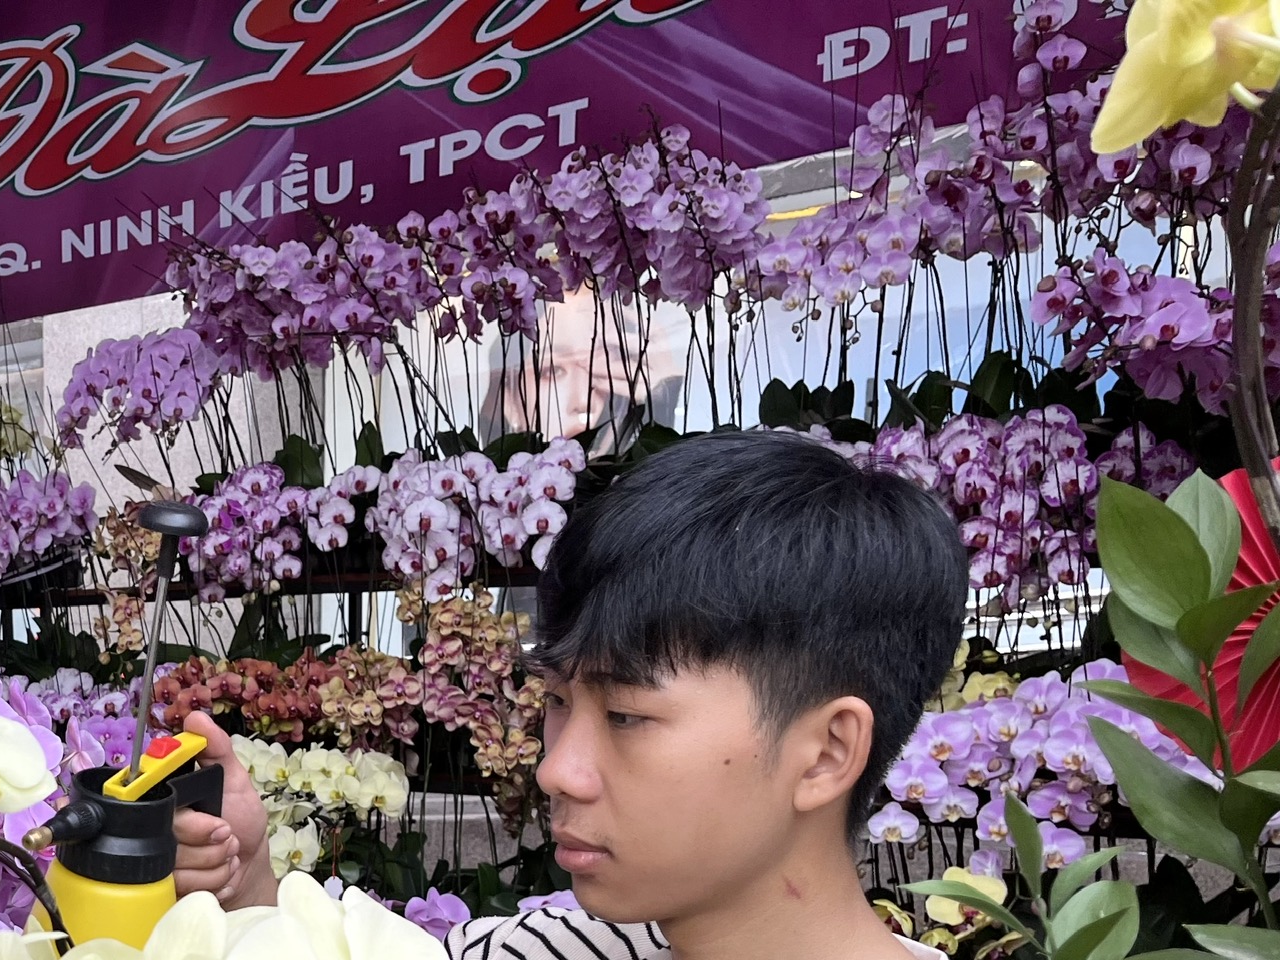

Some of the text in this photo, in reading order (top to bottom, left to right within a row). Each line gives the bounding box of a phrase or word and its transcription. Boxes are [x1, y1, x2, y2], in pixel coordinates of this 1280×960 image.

[816, 6, 969, 83] ĐT:
[61, 199, 195, 264] NINH
[219, 152, 375, 229] KIỀU,
[399, 97, 590, 184] TPCT
